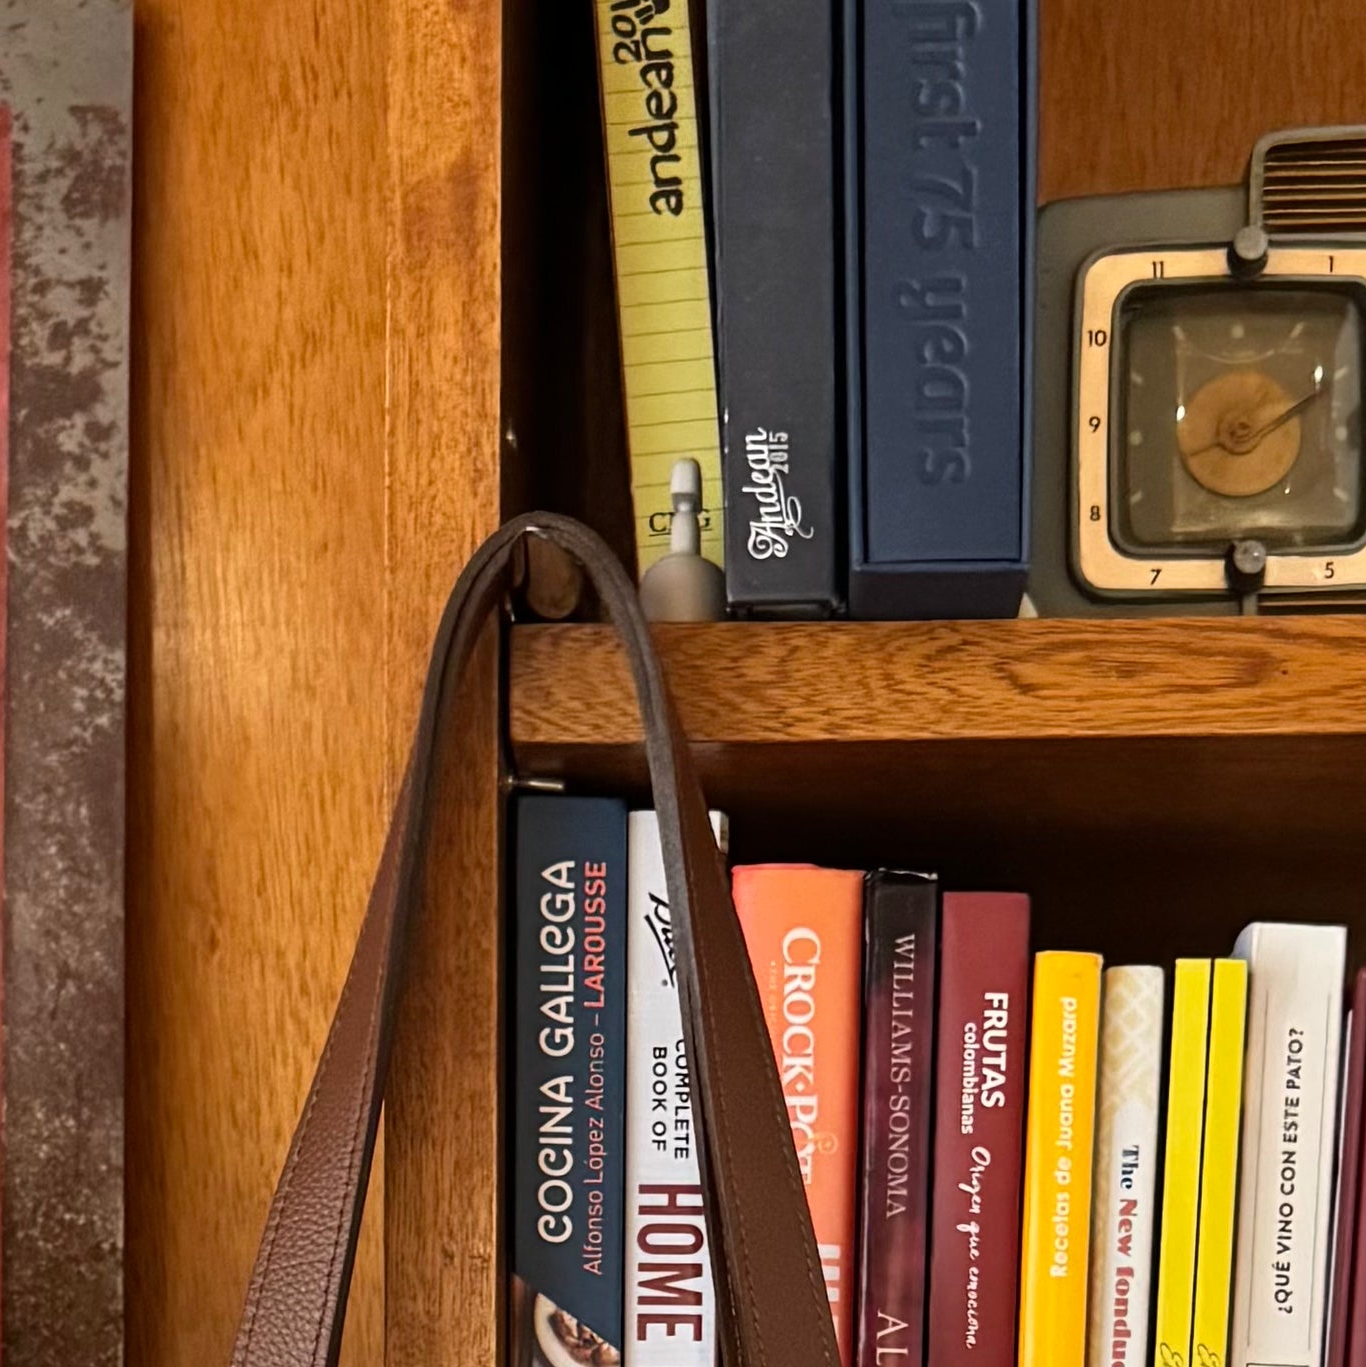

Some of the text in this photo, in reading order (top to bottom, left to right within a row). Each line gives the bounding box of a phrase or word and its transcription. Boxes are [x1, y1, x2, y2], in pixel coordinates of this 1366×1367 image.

[913, 163, 983, 250] 75
[1152, 261, 1165, 280] 11
[1328, 256, 1335, 273] 1
[1088, 330, 1107, 348] 10
[897, 272, 970, 486] years
[1089, 416, 1101, 432] 9
[769, 432, 789, 474] 2015
[742, 427, 814, 560] Andean
[1089, 506, 1101, 521] 8
[1149, 568, 1161, 585] 7
[1324, 562, 1335, 579] 5
[583, 861, 607, 1276] Alfonso López Alonso LAROUSSE
[886, 933, 915, 1219] WILLIAMS-SONOMA
[980, 992, 1009, 1108] FRUTAS
[1287, 1028, 1304, 1090] PATO?
[652, 1046, 667, 1152] BOOK OF
[960, 1022, 976, 1135] colombianas
[1049, 997, 1077, 1278] Recetas de Juana Muzard
[1284, 1096, 1300, 1144] ESTE
[538, 1075, 573, 1244] COCINA
[961, 1145, 991, 1214] Origen
[1120, 1145, 1140, 1190] The
[1281, 1151, 1296, 1195] CON
[957, 1218, 981, 1260] que
[1117, 1199, 1138, 1257] New
[1278, 1202, 1294, 1254] VINO
[636, 1184, 704, 1342] HOME
[875, 1312, 909, 1366] AL
